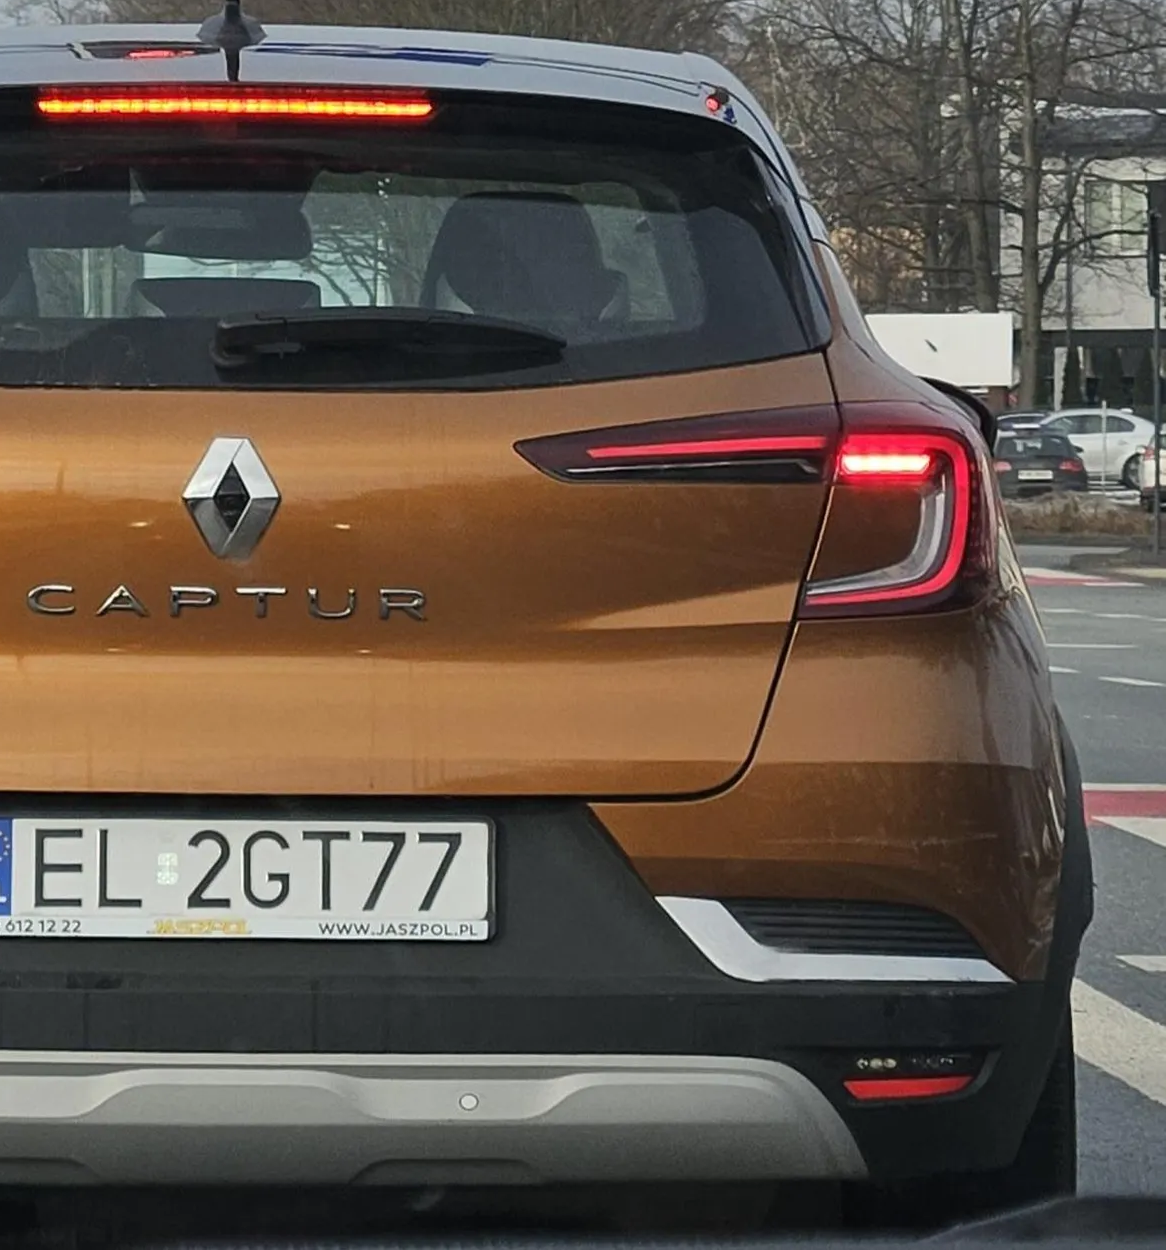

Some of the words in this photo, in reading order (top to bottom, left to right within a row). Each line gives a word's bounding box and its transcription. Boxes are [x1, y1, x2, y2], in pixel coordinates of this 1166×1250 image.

[27, 584, 428, 621] CAPTUR
[34, 829, 143, 908] EL
[187, 830, 462, 911] 2GT77
[5, 919, 34, 932] 612
[38, 919, 56, 933] 12
[61, 919, 82, 933] 22
[318, 923, 478, 936] WWW.JASZPOL.PL
